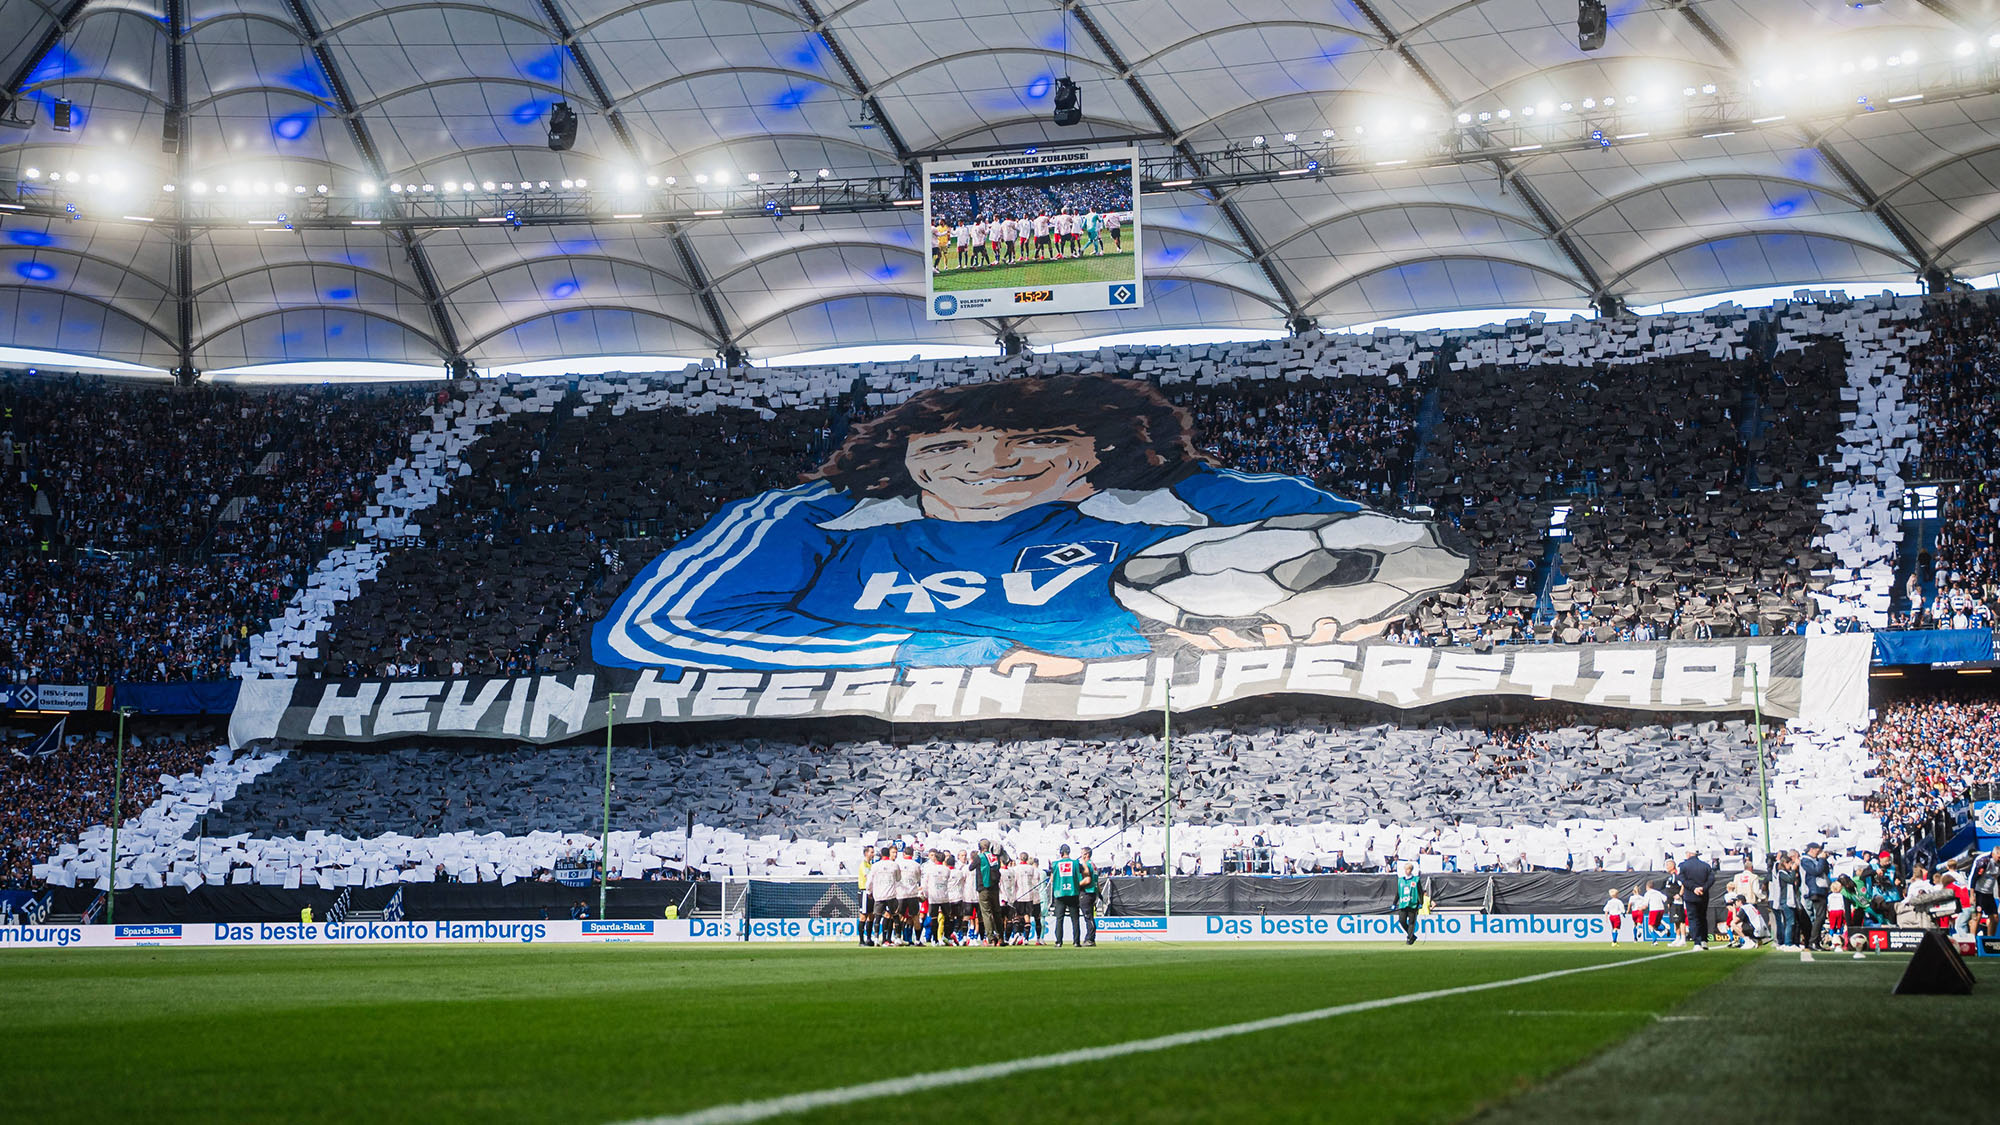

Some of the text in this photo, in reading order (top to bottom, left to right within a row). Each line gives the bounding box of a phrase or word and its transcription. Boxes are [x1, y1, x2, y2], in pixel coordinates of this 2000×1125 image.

[972, 152, 1089, 168] WILLKOMMEN ZUHAUSE!
[1016, 291, 1050, 303] 15:27
[854, 563, 1100, 613] HSV
[307, 644, 1772, 737] KEVIN KEEGAN SUPERSTAR!
[122, 926, 175, 936] Sparda-Bank
[215, 920, 546, 943] Das beste Girokonto Hamburgs
[590, 923, 646, 932] Sparda-Bank
[690, 918, 731, 937] Das
[1098, 920, 1159, 929] Sparda-Bank
[1206, 915, 1252, 934] Das
[1261, 915, 1328, 934] beste
[1470, 914, 1604, 938] Hamburgs
